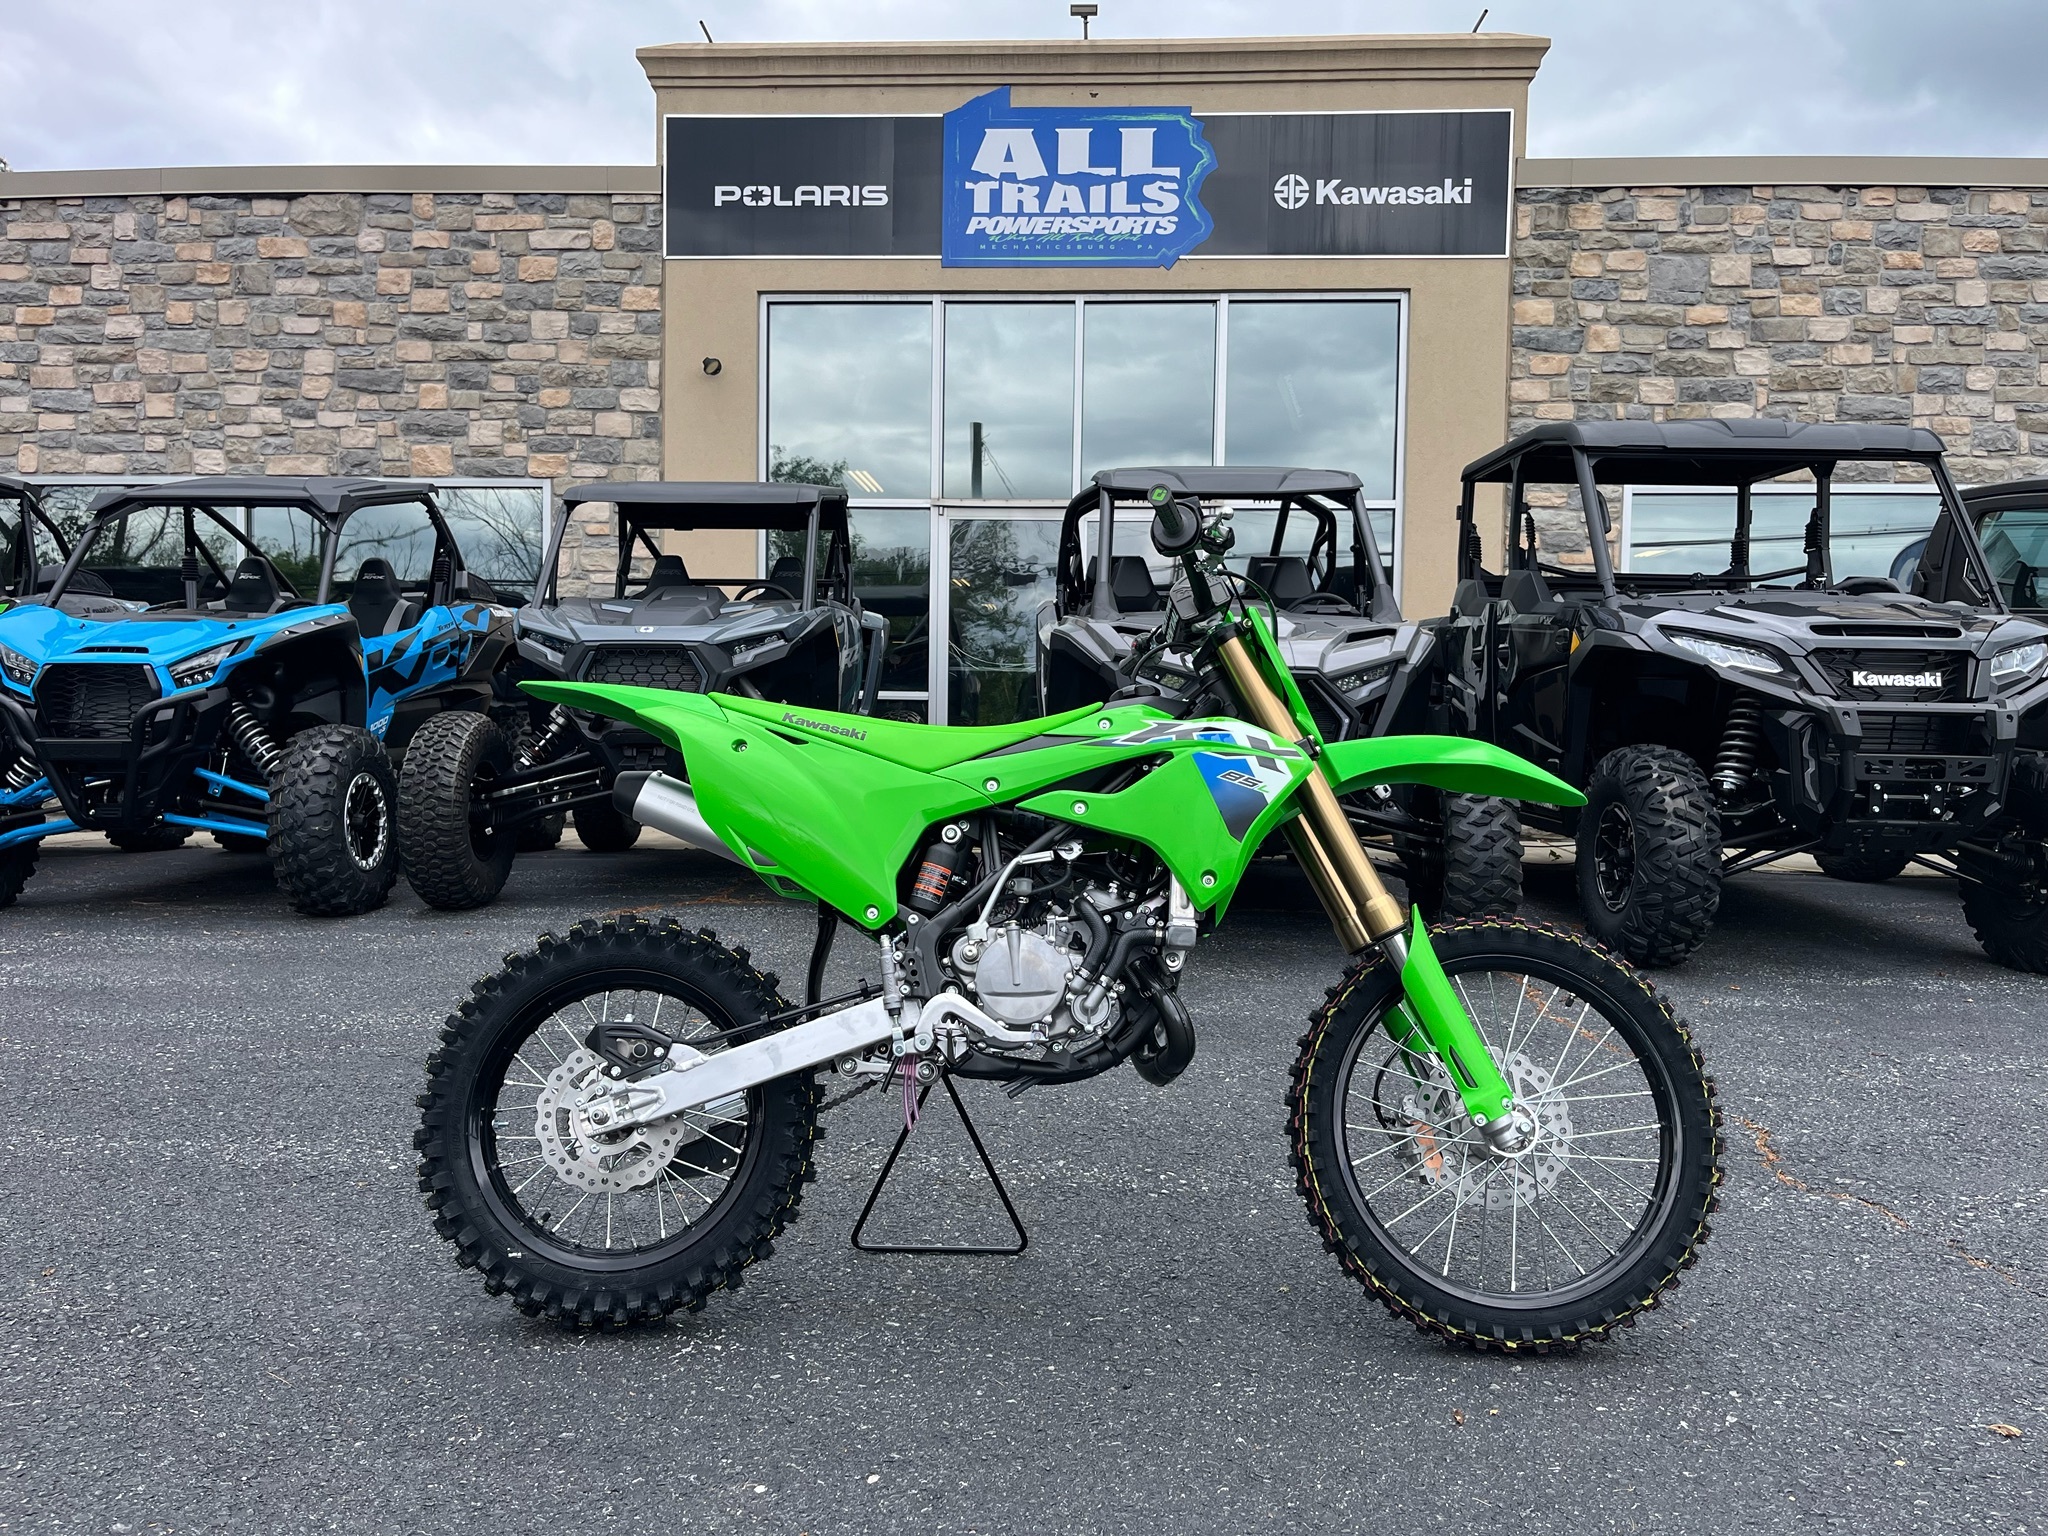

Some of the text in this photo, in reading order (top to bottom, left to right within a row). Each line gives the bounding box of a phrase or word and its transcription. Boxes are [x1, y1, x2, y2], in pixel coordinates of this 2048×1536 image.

[970, 127, 1181, 181] ALL
[714, 185, 889, 207] POLARIS
[964, 180, 1181, 214] TRAILS
[1315, 178, 1473, 205] Kawasaki
[965, 215, 1179, 235] POWERSPORTS
[1852, 671, 1942, 687] Kawasaki
[781, 712, 868, 741] Kawasaki
